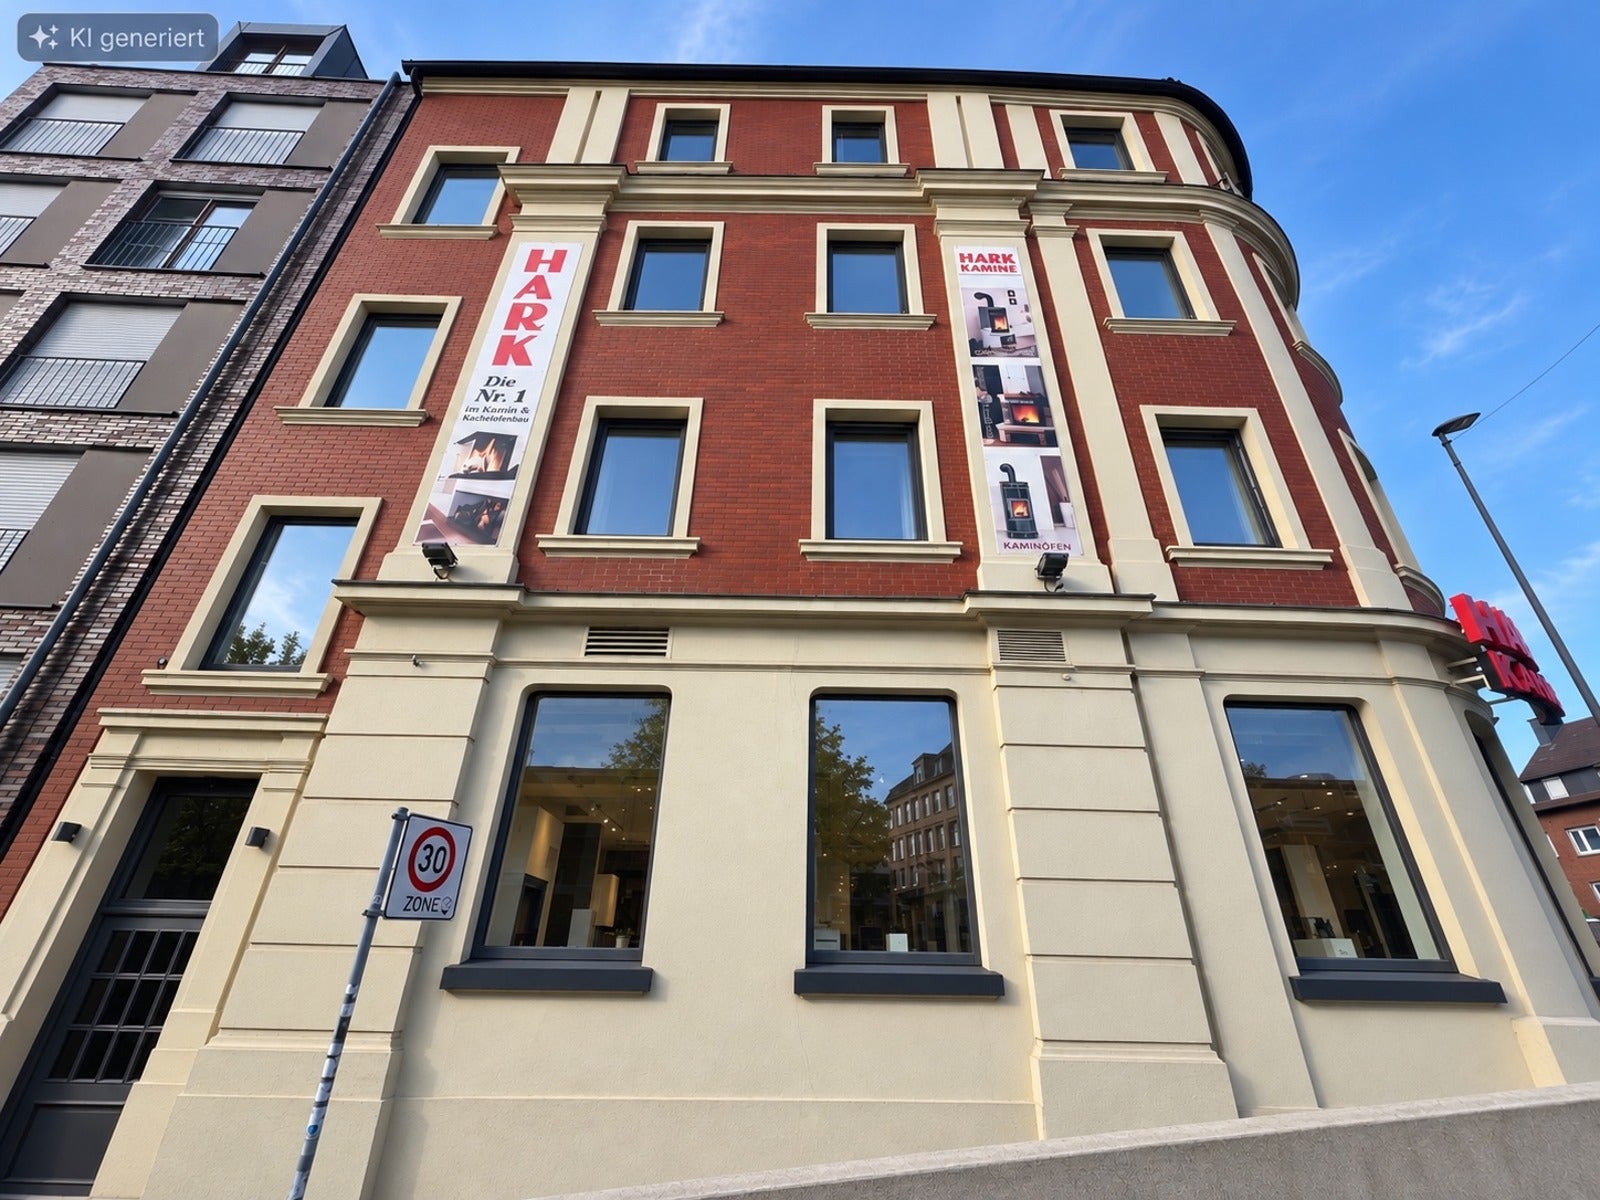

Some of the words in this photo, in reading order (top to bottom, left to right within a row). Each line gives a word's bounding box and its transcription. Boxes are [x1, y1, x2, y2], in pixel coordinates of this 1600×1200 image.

[958, 252, 1017, 265] HARK
[960, 264, 1018, 274] KAMINE
[491, 249, 568, 367] HARK
[483, 375, 517, 388] Die
[474, 388, 507, 403] Nr.
[513, 388, 527, 403] 1
[464, 405, 480, 413] im
[481, 405, 518, 415] Kamin
[520, 406, 530, 414] &
[462, 414, 530, 423] Kachelofenbau
[417, 843, 448, 874] 30
[402, 895, 441, 913] ZONE
